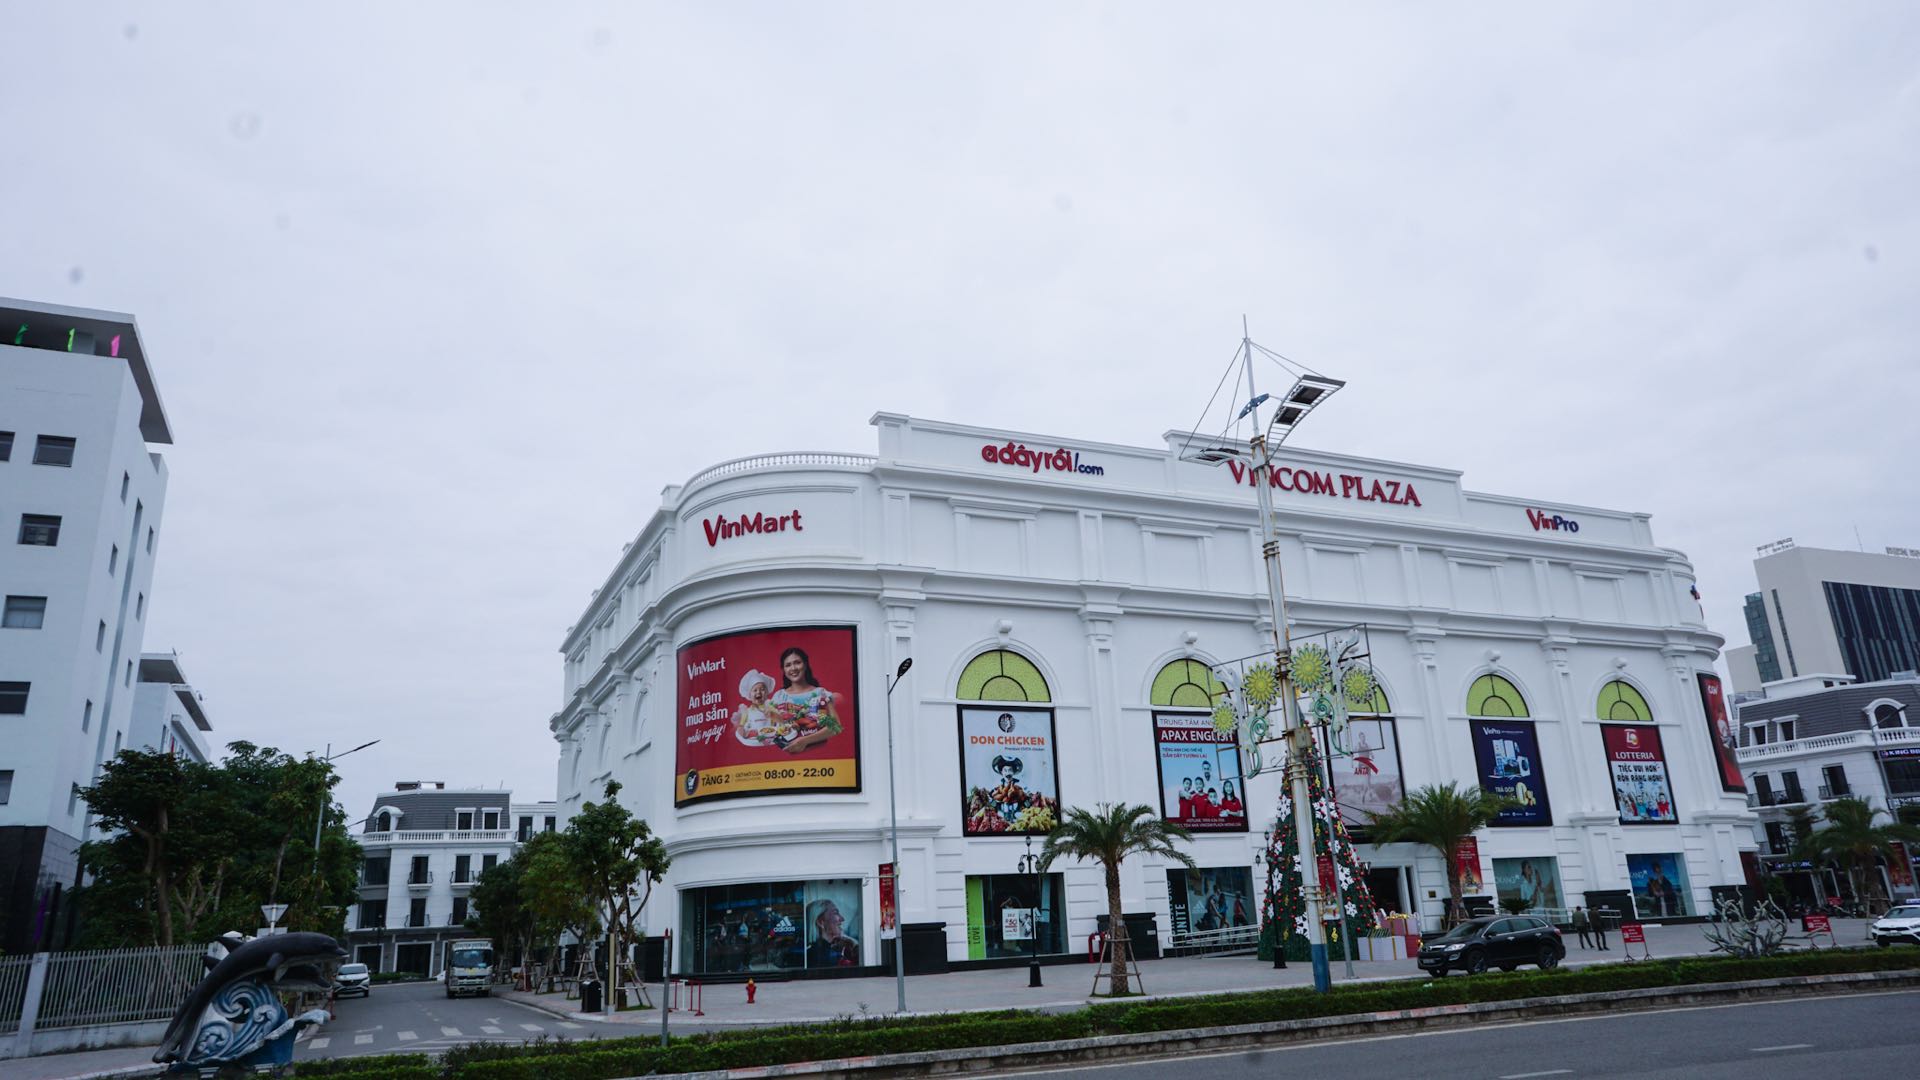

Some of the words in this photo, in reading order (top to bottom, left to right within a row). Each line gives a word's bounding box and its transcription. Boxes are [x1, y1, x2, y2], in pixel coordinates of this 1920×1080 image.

[1339, 474, 1421, 507] PLAZA
[702, 509, 803, 548] VinMart
[1525, 507, 1580, 533] VinPro
[687, 657, 726, 680] VinMart
[688, 696, 700, 710] An
[702, 691, 722, 706] tâm
[685, 712, 704, 728] mua
[705, 704, 729, 722] sắm
[1160, 718, 1184, 726] TRUNG
[1184, 717, 1199, 727] TÂM
[970, 735, 996, 746] DON
[996, 736, 1046, 746] CHICKEN
[1161, 730, 1189, 741] APAX
[1615, 752, 1655, 760] LOTTERIA
[702, 774, 724, 787] TẦNG
[724, 774, 731, 784] 2
[764, 769, 795, 780] 08:00
[803, 767, 835, 778] 22:00
[1175, 904, 1188, 936] UNITE
